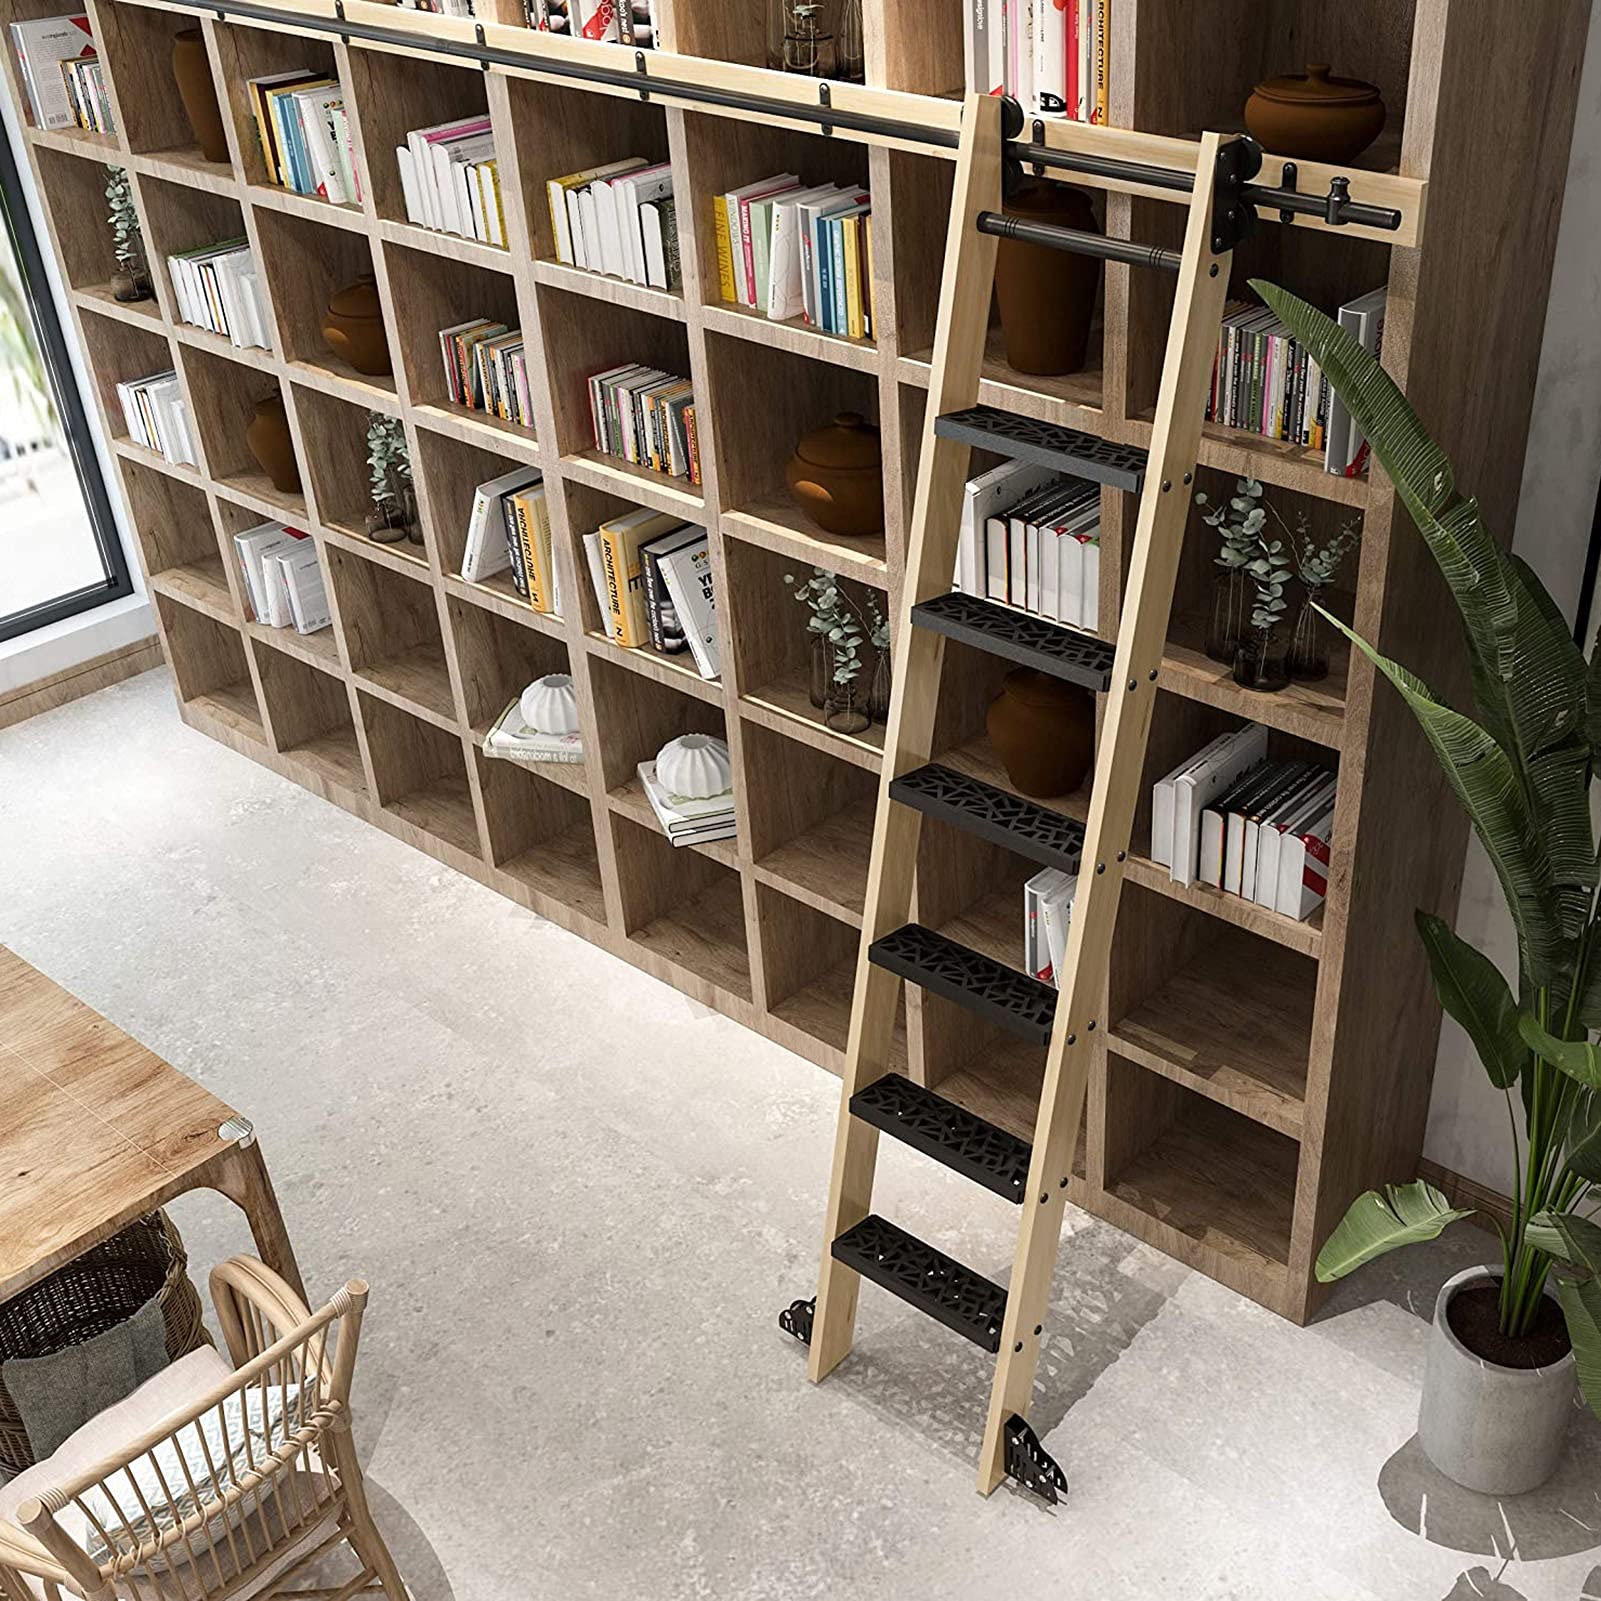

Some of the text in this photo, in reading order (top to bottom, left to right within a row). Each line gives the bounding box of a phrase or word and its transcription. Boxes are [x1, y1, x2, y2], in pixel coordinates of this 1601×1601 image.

[715, 211, 731, 287] FINE WINES
[603, 538, 623, 637] ARCHITECTURE N
